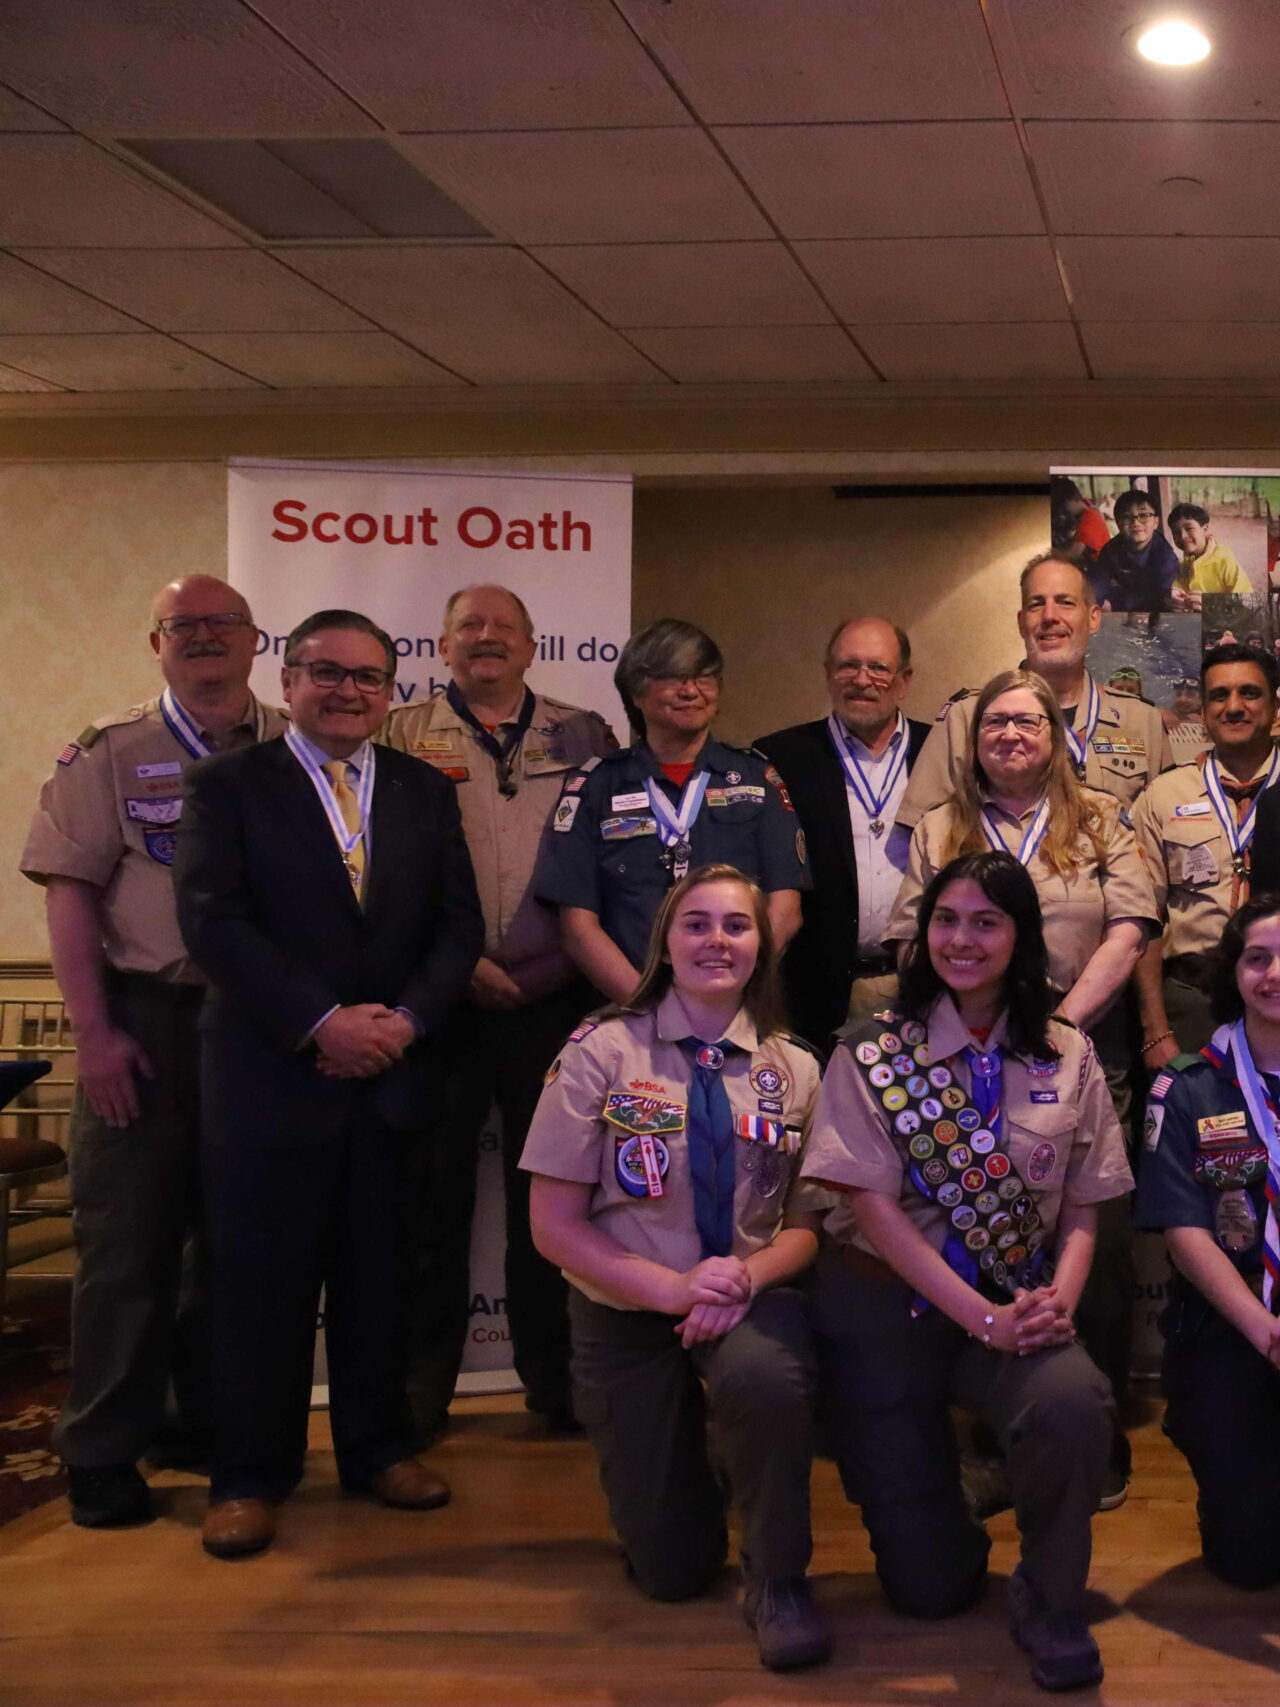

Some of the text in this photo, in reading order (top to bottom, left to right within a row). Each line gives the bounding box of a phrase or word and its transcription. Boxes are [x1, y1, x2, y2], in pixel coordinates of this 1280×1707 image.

[271, 499, 592, 552] Scout Oath
[540, 635, 564, 661] ill
[577, 636, 619, 662] do
[644, 1081, 666, 1095] BSA
